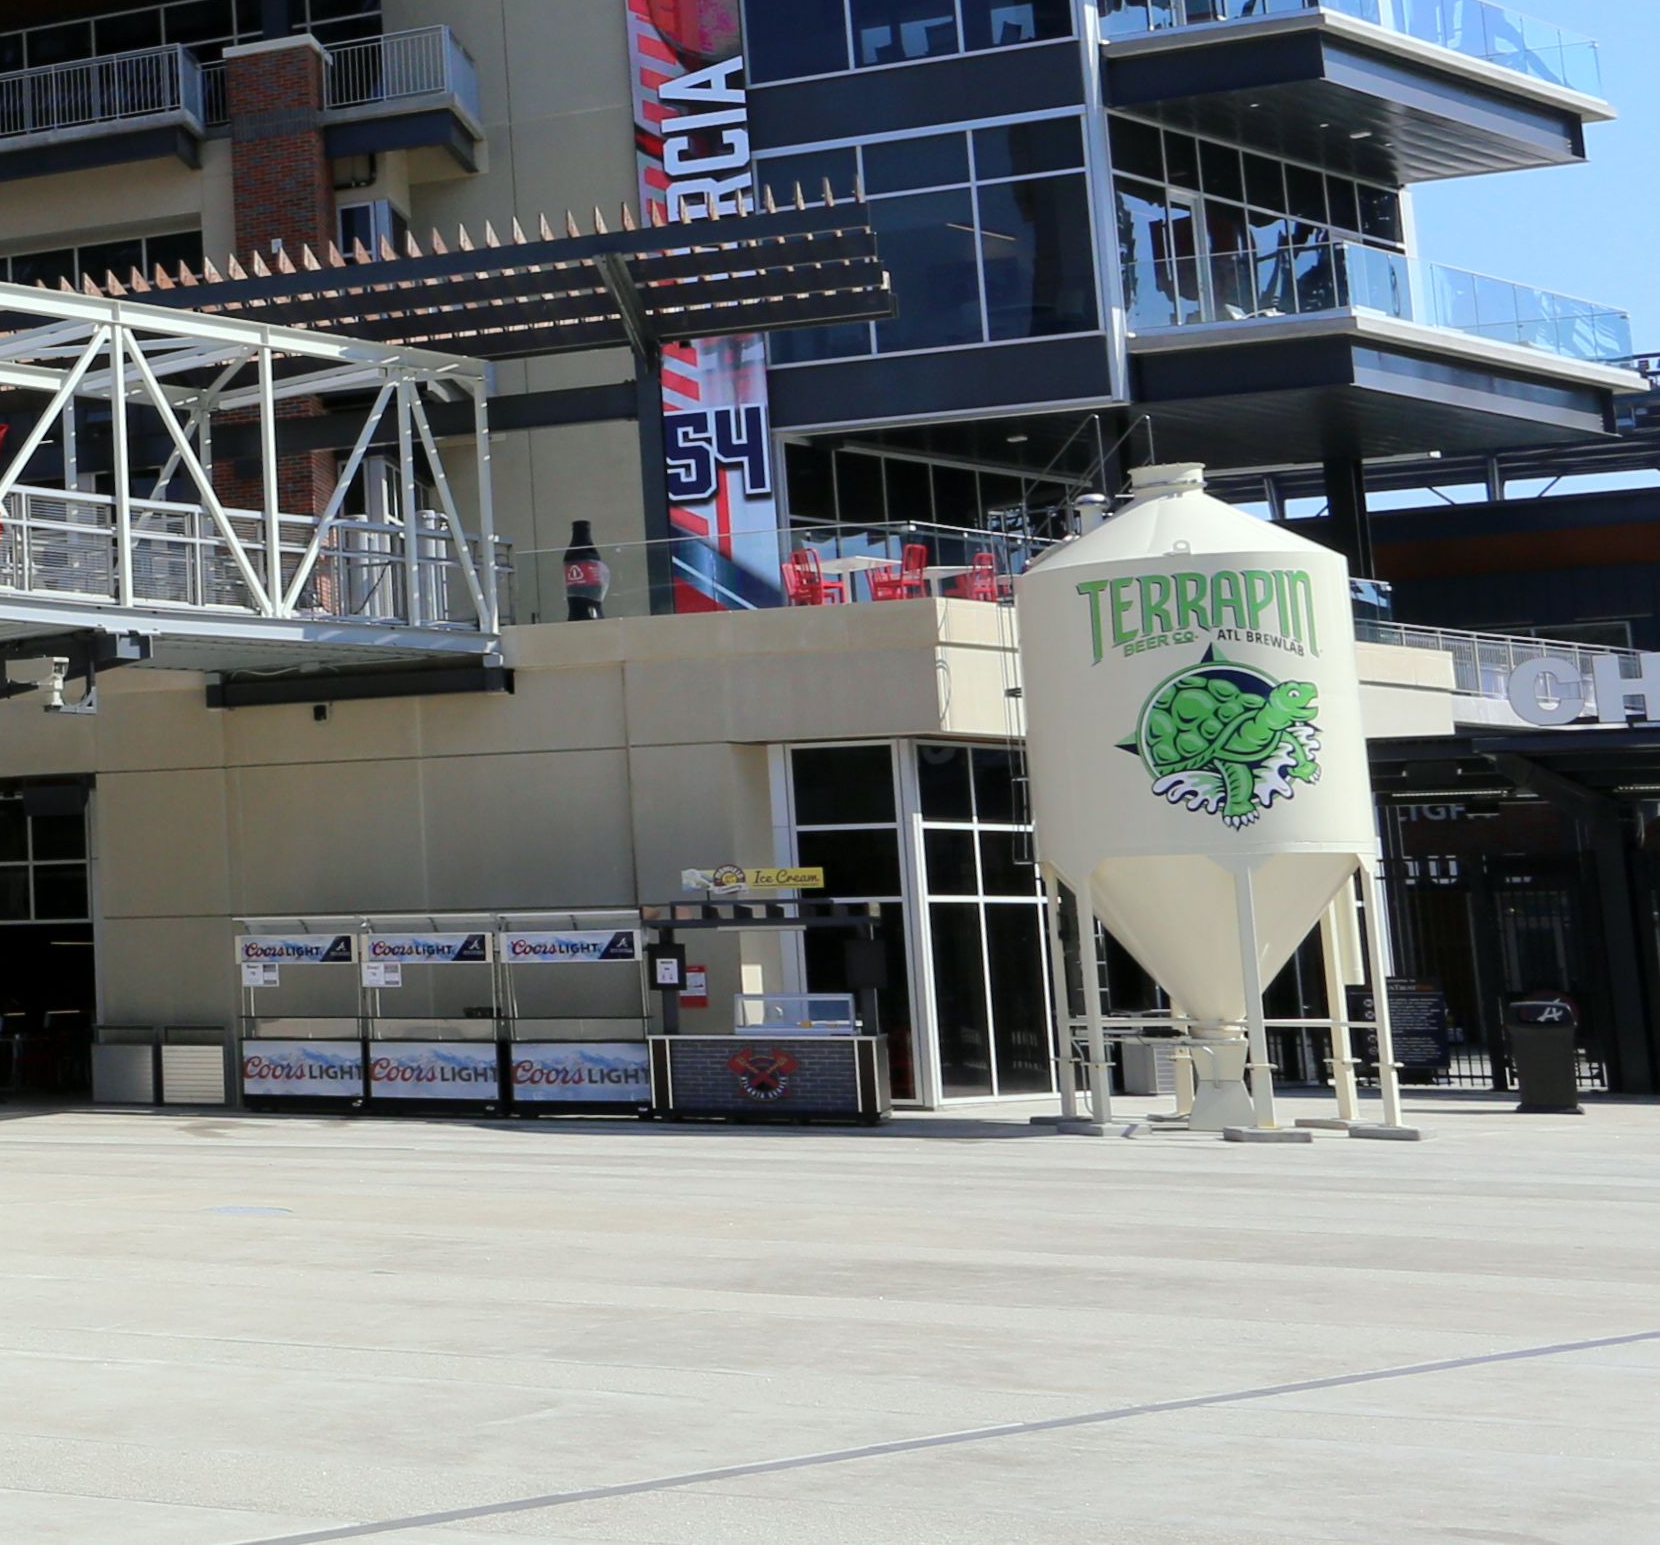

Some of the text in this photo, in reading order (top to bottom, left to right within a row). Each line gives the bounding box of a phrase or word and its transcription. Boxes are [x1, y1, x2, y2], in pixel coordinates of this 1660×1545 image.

[658, 54, 754, 223] RCIA
[665, 403, 772, 501] 54
[1076, 569, 1320, 667] TERRAPIN
[1123, 635, 1169, 658] BEER
[1217, 628, 1241, 642] ATL
[1246, 632, 1305, 657] BREWLAB
[753, 869, 818, 884] Ice Cream
[245, 941, 285, 958] Coors
[285, 945, 320, 958] LIGHT
[370, 940, 413, 957] Coors
[414, 944, 453, 957] LIGHT
[510, 939, 558, 956] Coors
[558, 943, 600, 955] LIGHT
[243, 1055, 363, 1081] Coors LIGHT
[370, 1057, 498, 1083] Coors LIGHT
[512, 1059, 650, 1085] Coors LIGHT
